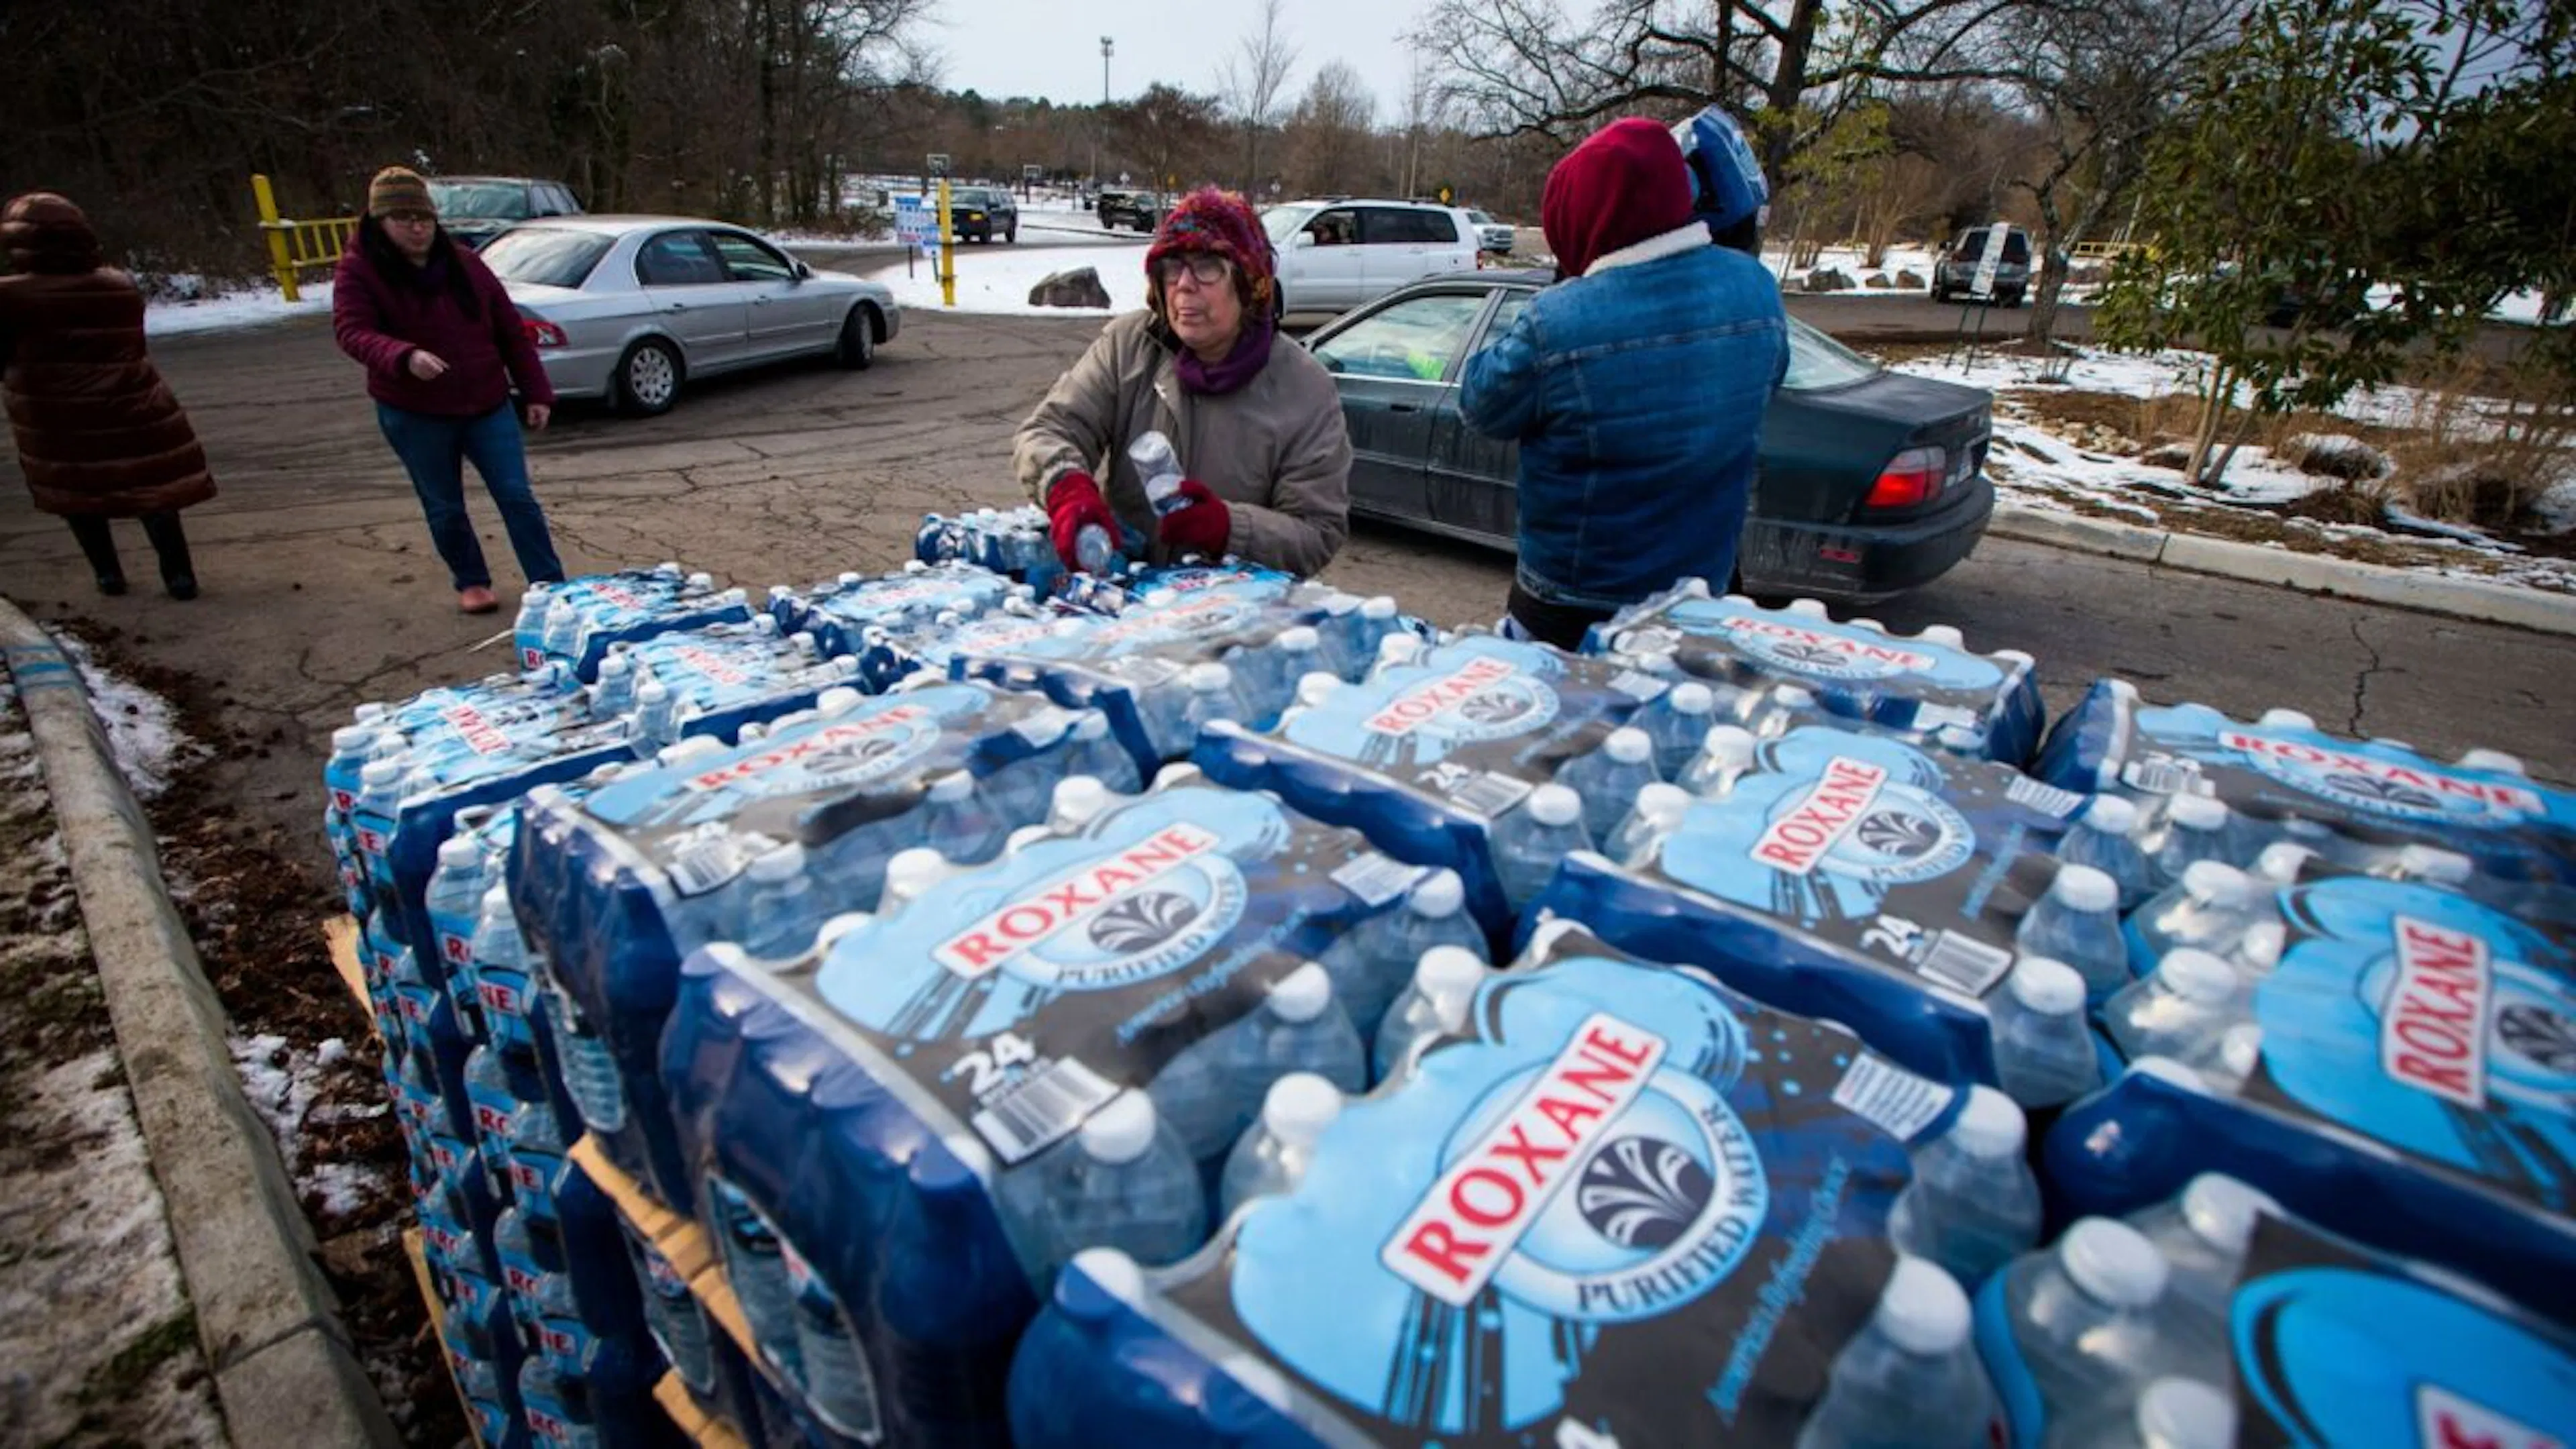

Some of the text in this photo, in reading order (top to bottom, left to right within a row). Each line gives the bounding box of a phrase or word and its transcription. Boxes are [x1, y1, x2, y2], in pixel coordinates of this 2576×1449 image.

[1732, 619, 1921, 666] ROXANE
[1373, 657, 1511, 730] ROXANE
[695, 704, 929, 789] ROXANE
[2231, 735, 2517, 808] ROXANE
[1760, 763, 1880, 867] ROXANE
[949, 830, 1208, 967] ROXANE
[1858, 914, 1923, 958] 24
[1055, 930, 1206, 985] PURIFIED
[2393, 926, 2477, 1095] ROXANE
[951, 1030, 1036, 1095] 24
[1404, 1026, 1652, 1286] ROXANE
[1578, 1215, 1750, 1312] PURIFIED
[1699, 1099, 1760, 1207] WATER
